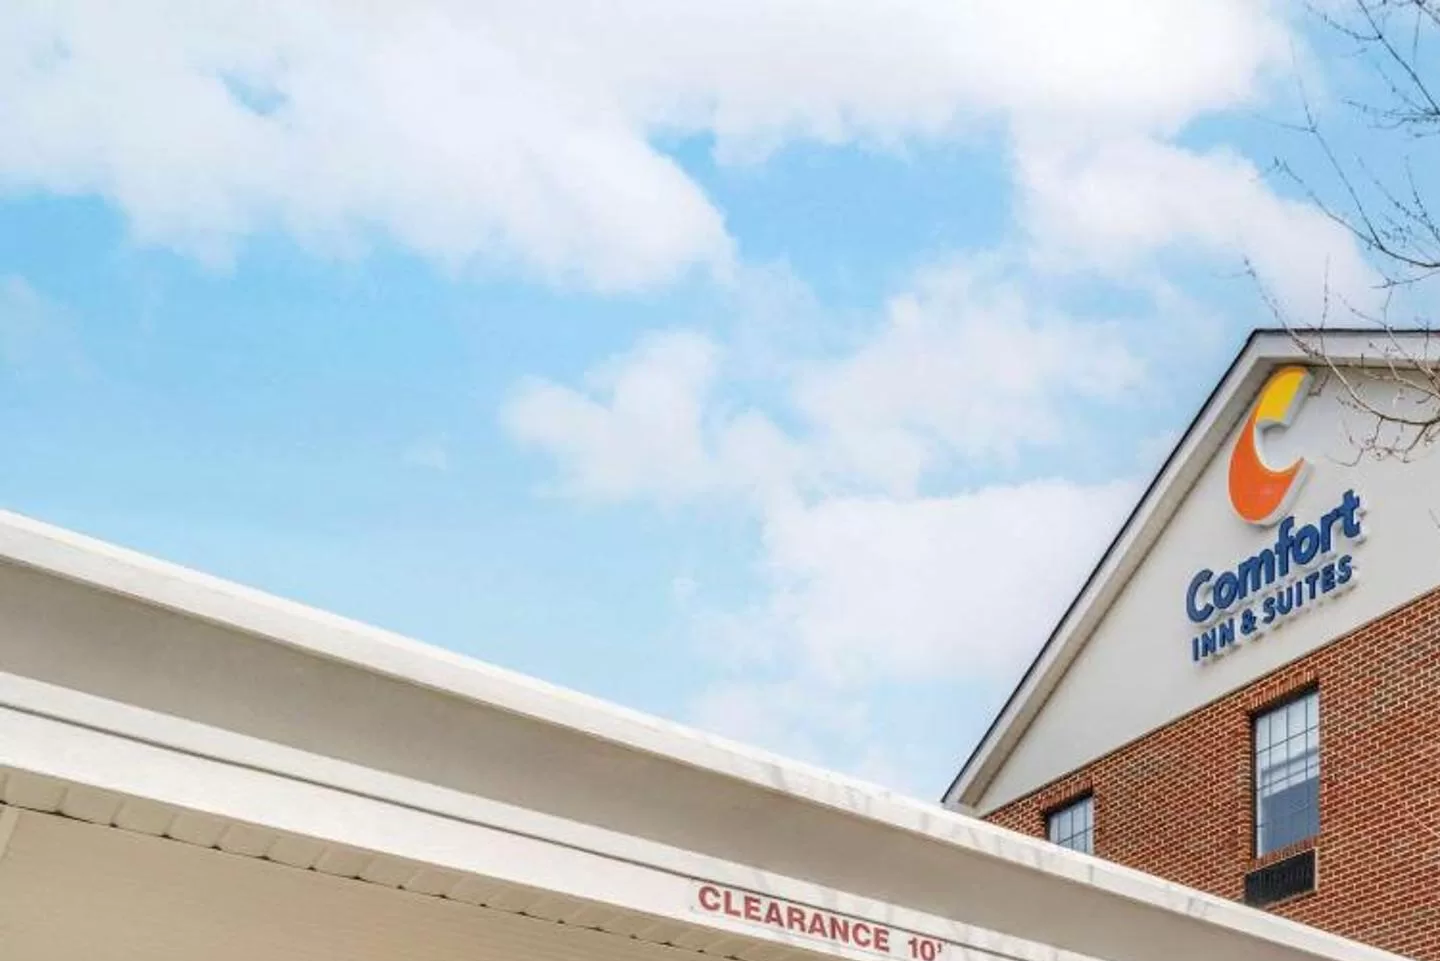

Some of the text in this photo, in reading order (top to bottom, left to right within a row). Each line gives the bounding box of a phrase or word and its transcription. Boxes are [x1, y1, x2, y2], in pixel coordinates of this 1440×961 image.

[1186, 489, 1360, 623] Comfort
[1191, 555, 1353, 662] INN & SUITES
[698, 885, 890, 952] CLEARANCE
